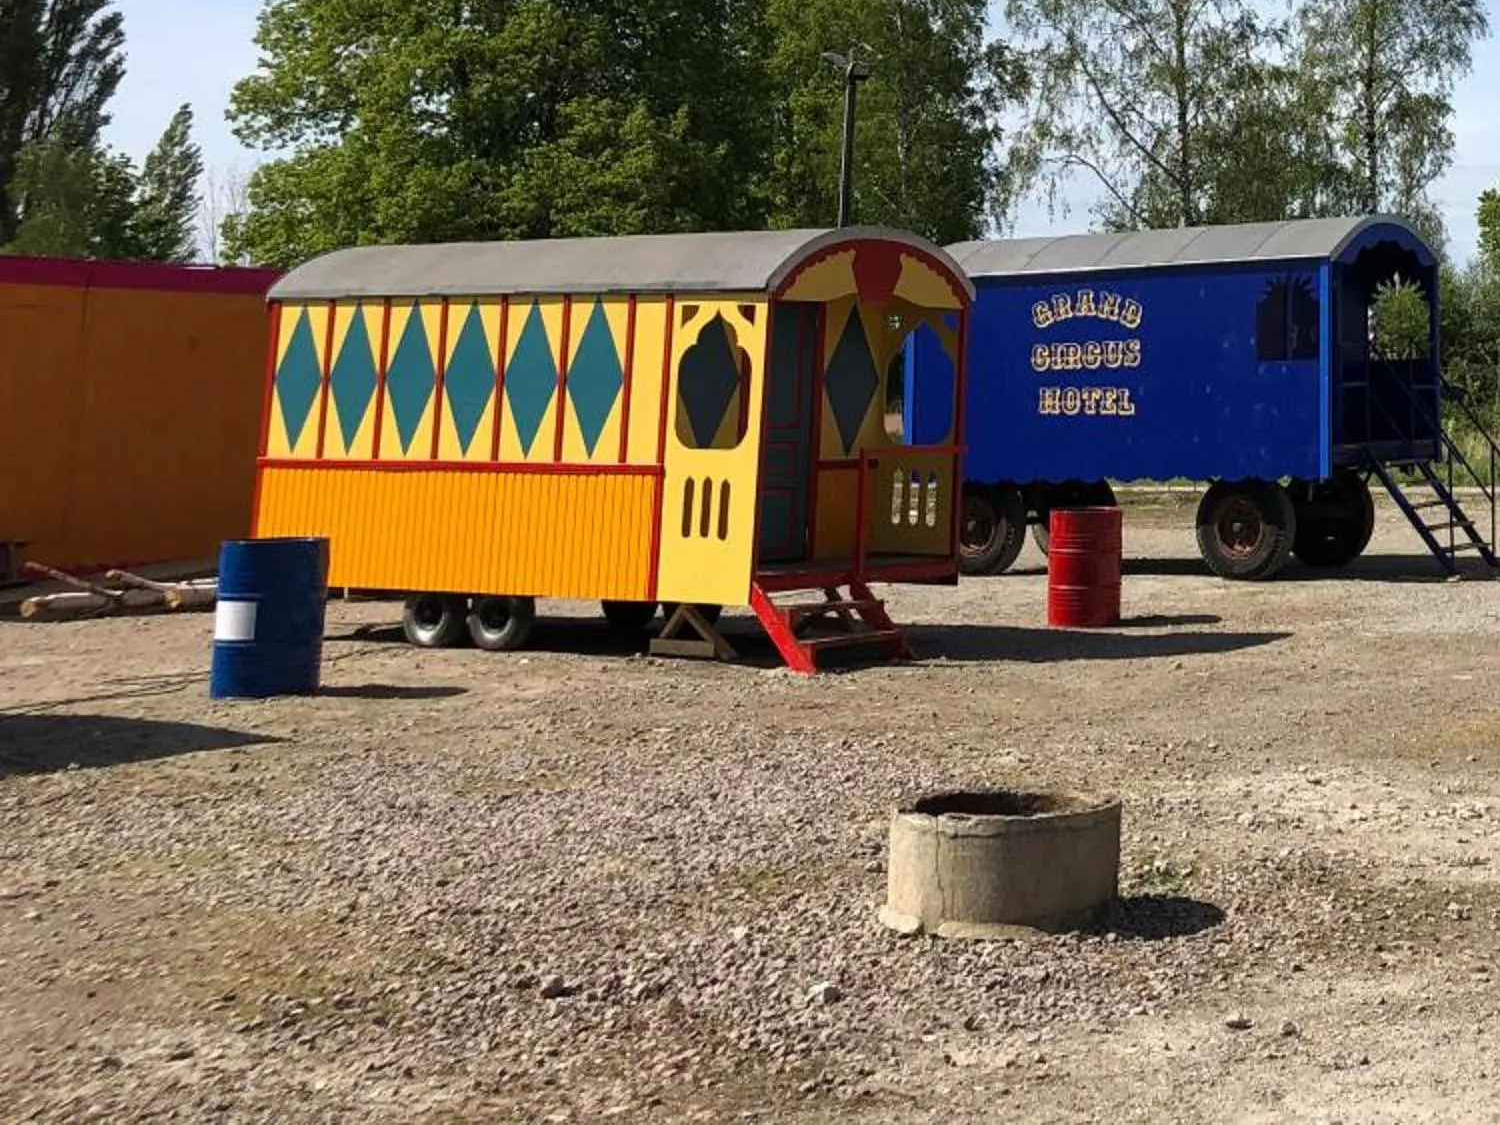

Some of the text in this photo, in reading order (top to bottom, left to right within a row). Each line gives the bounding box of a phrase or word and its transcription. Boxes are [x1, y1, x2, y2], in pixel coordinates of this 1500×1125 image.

[1031, 289, 1143, 328] GRAND
[1031, 339, 1141, 372] CIRCUS
[1038, 386, 1136, 416] HOTEL
